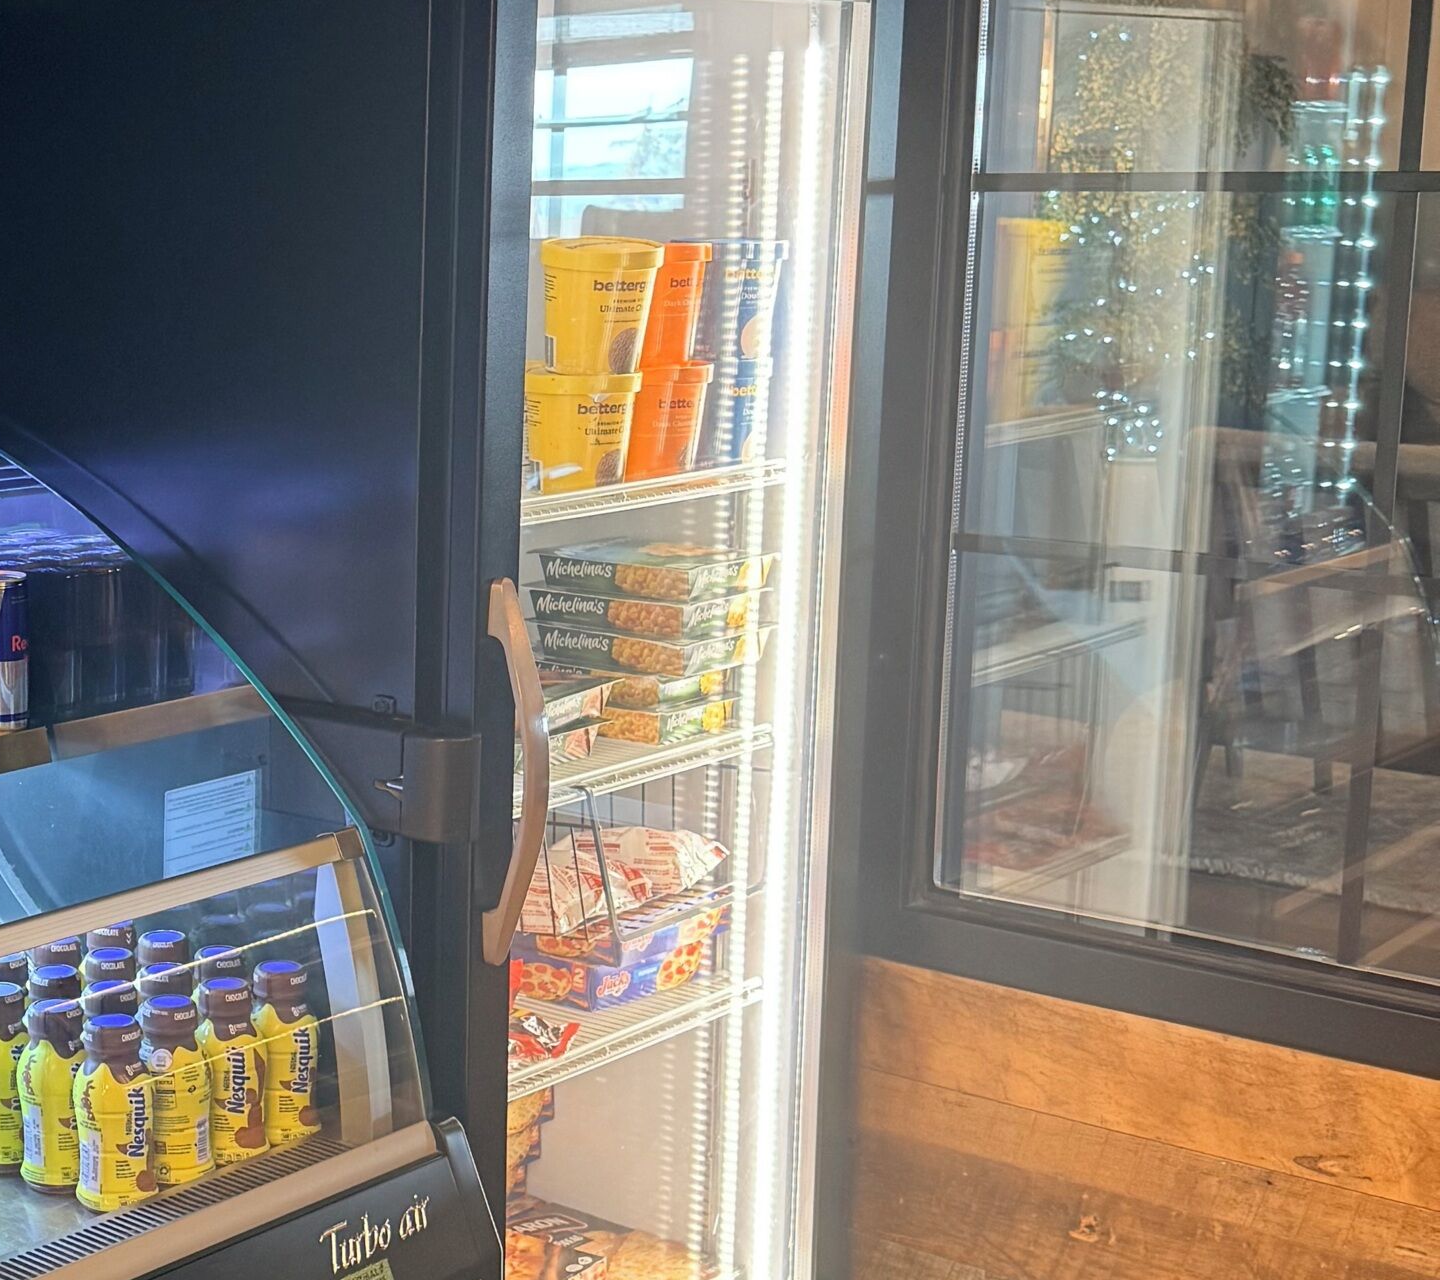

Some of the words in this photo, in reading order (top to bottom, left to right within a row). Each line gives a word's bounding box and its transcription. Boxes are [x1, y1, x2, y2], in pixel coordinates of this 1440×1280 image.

[599, 304, 635, 313] Ultimate
[546, 559, 613, 578] Michelina's
[536, 593, 606, 615] Michelina's
[544, 630, 610, 652] Michelina's
[226, 1046, 250, 1115] Nesquik
[292, 1026, 313, 1094] Nesquik
[126, 1086, 147, 1158] Nesquik
[319, 1210, 392, 1275] Turbo
[398, 1193, 430, 1241] air
